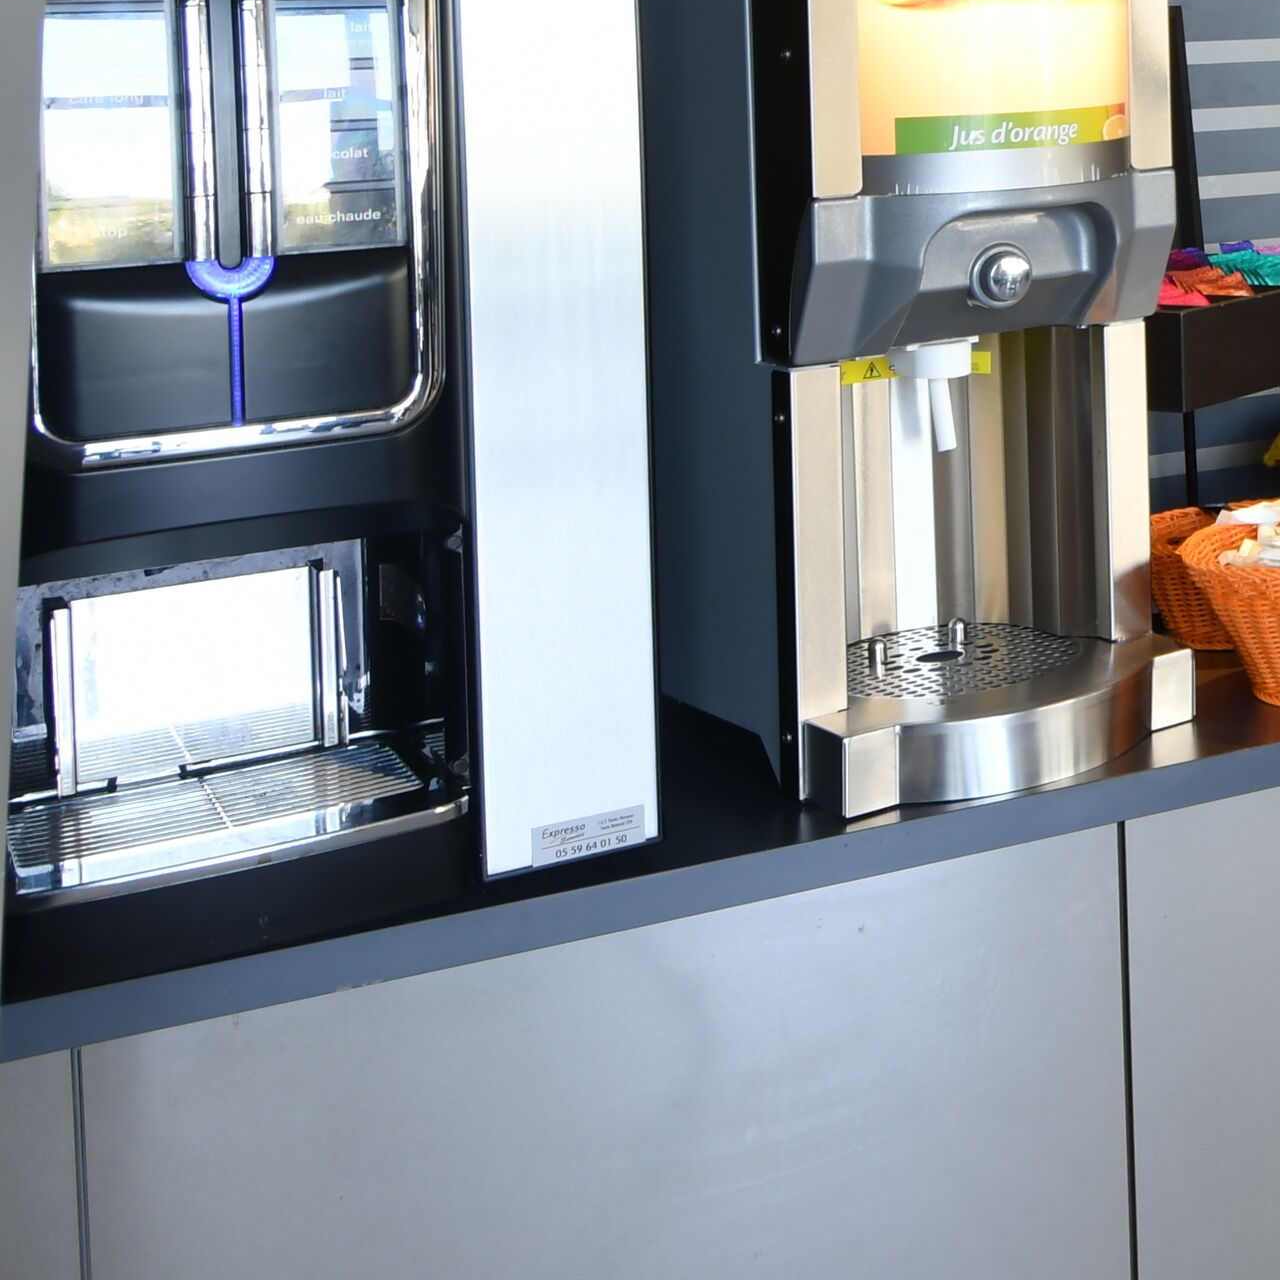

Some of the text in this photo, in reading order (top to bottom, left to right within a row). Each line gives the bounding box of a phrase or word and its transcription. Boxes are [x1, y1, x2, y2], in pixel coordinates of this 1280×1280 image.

[323, 88, 346, 98] lait
[948, 122, 1078, 151] Jus d'orange
[331, 147, 369, 159] colat
[329, 208, 381, 223] chaude
[541, 823, 586, 839] Expresso
[555, 834, 627, 858] 05 59 64 01 50
